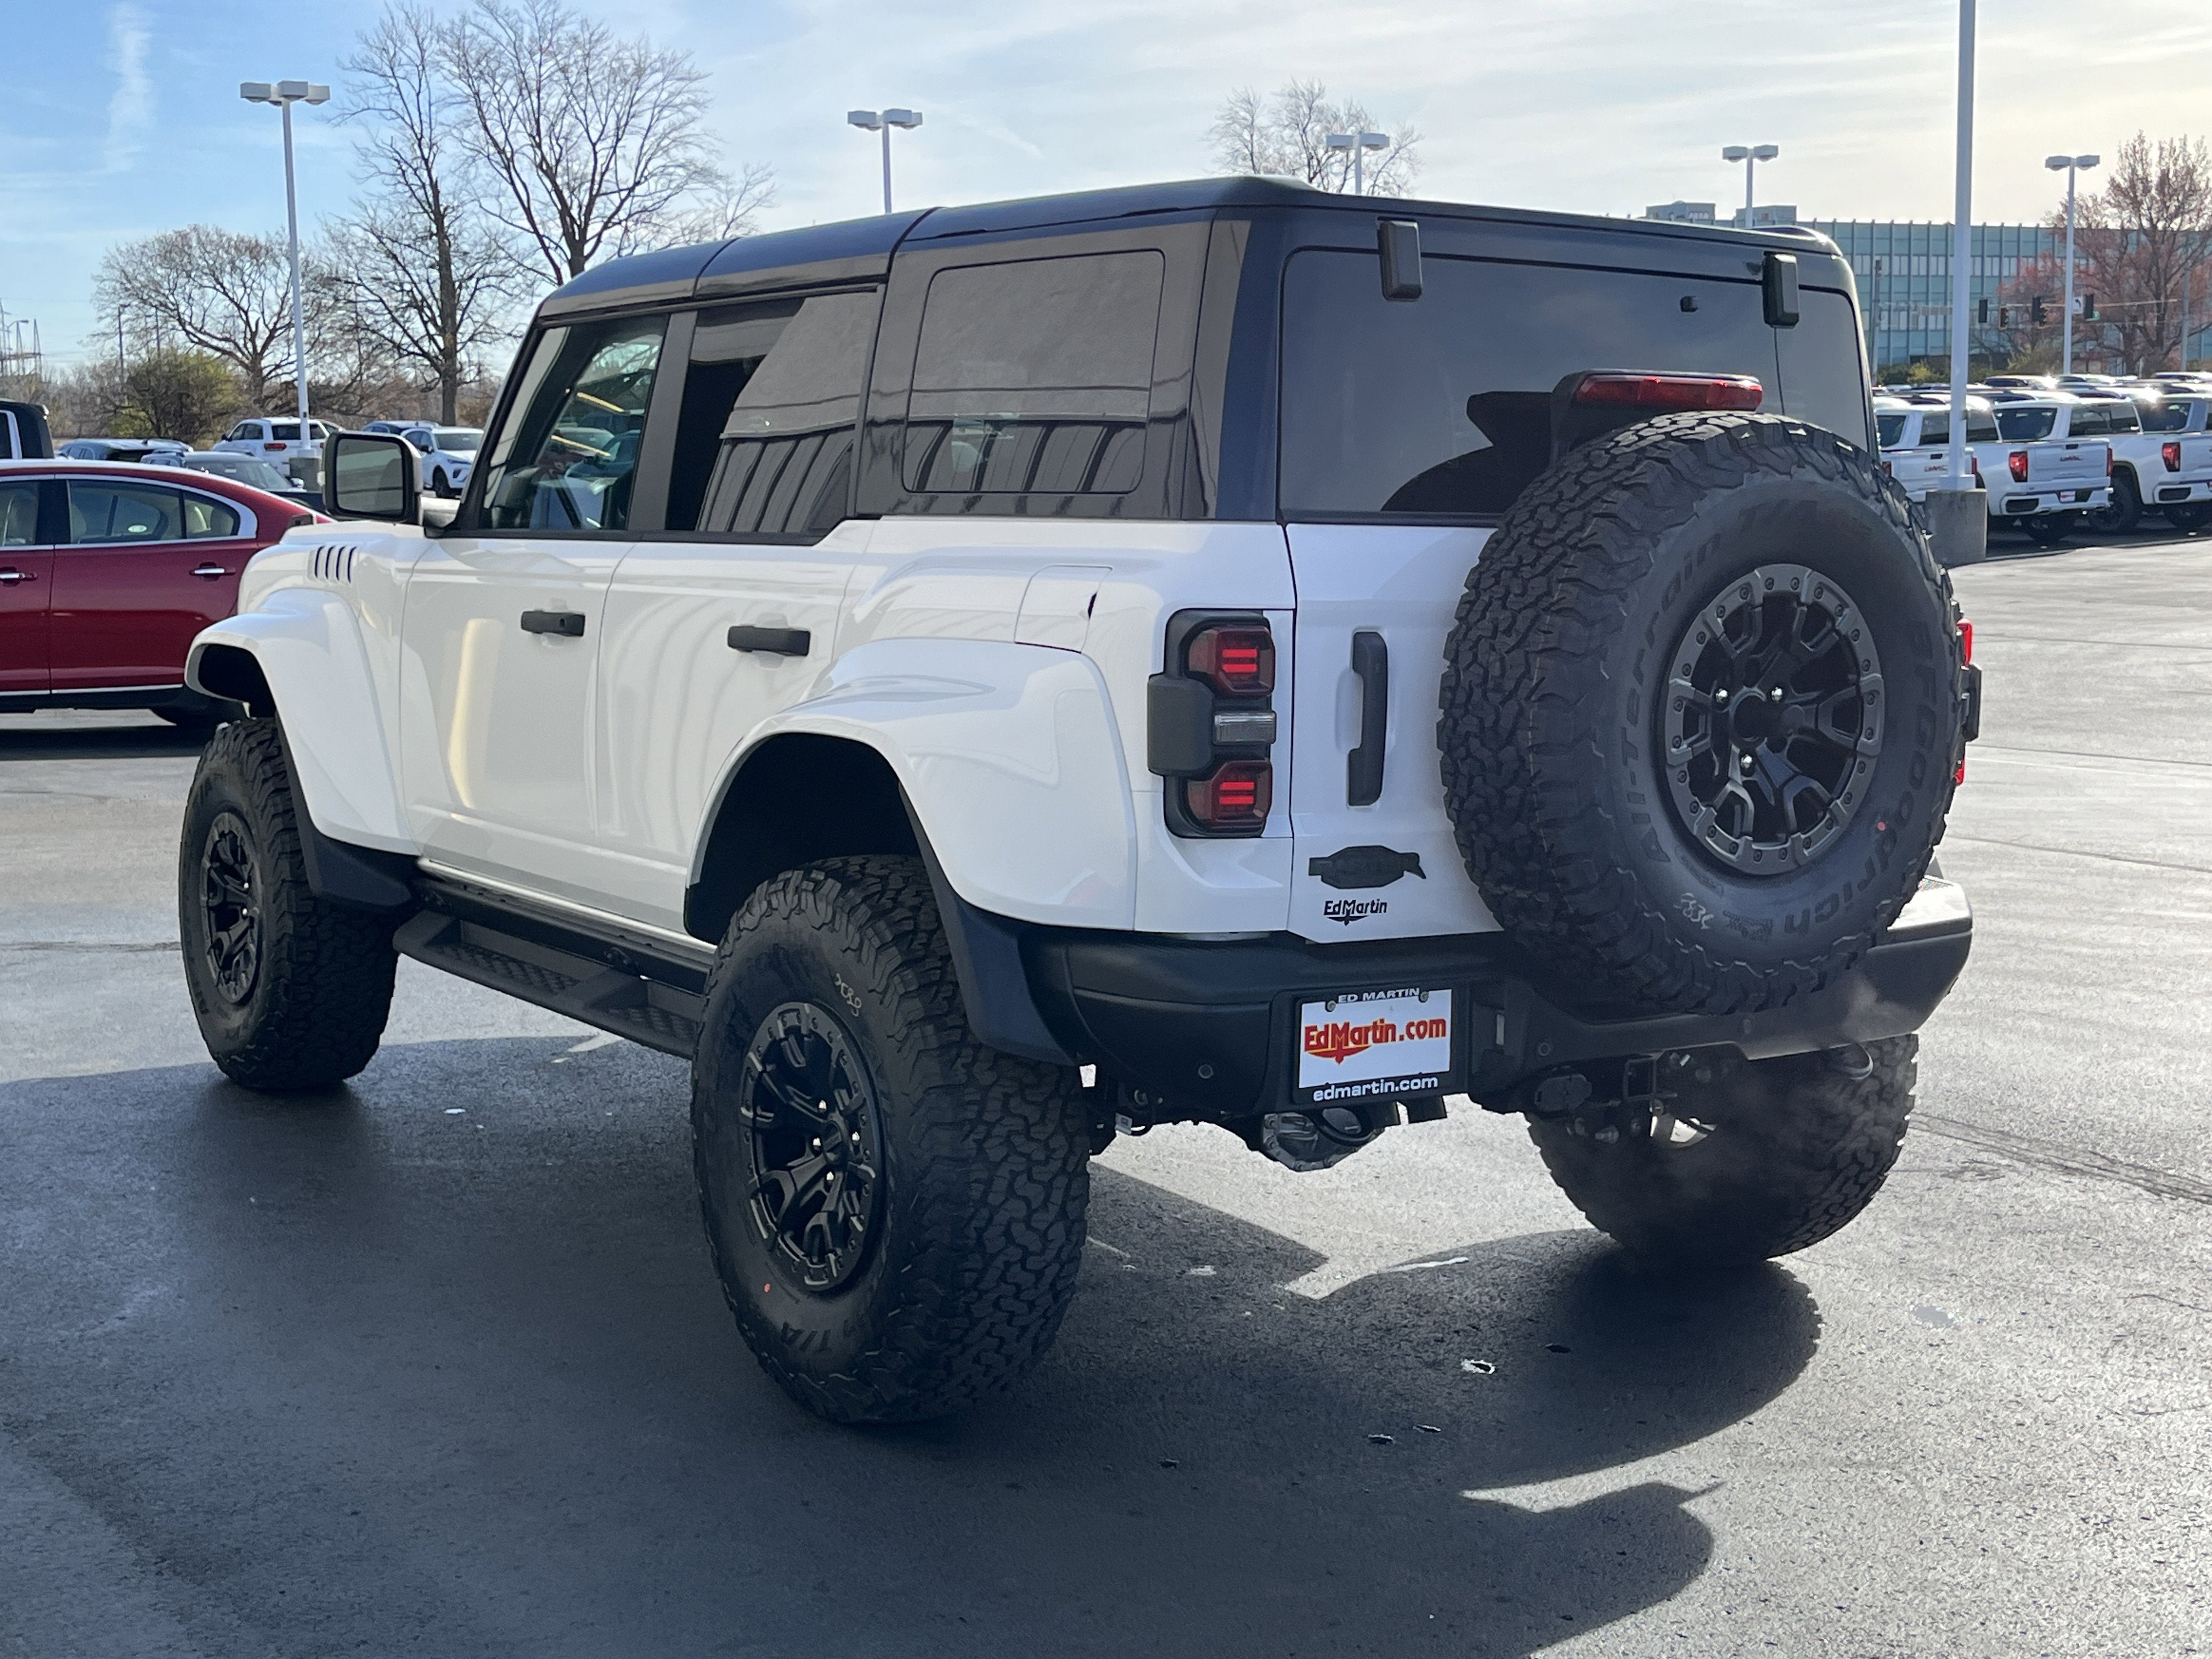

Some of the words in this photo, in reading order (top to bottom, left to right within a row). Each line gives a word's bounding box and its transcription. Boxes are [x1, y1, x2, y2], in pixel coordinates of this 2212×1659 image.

[1338, 995, 1358, 1003] ED
[1362, 988, 1420, 1001] MARTIN
[1313, 1077, 1438, 1102] edmartin.com
